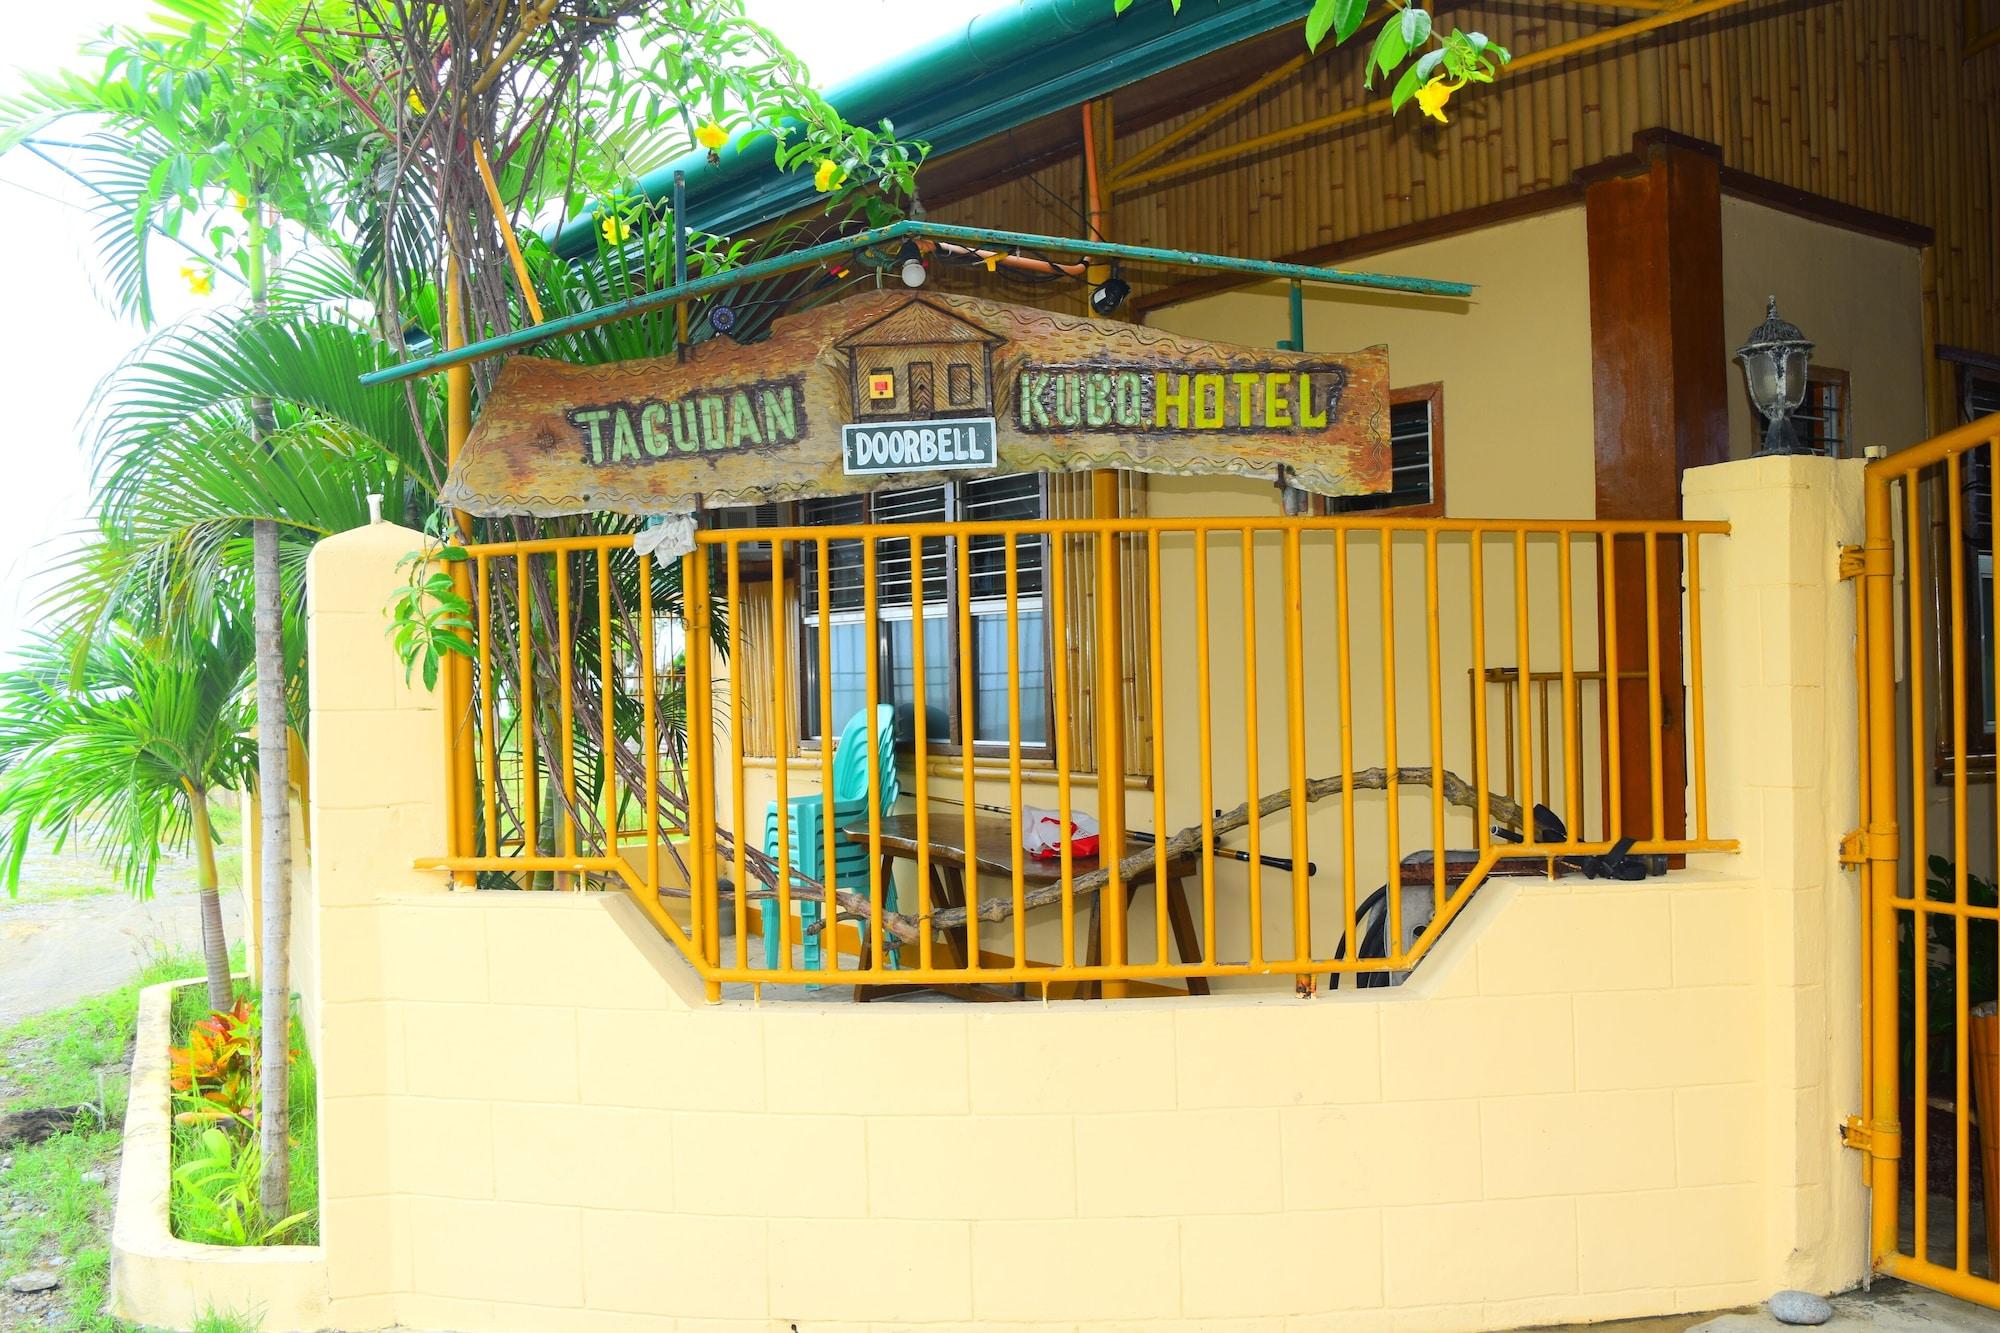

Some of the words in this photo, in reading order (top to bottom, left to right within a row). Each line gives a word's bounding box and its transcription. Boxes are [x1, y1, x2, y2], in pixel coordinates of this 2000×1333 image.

[575, 386, 796, 464] TAGUDAN
[1156, 371, 1328, 429] HOTEL
[855, 427, 985, 465] DOORBELL
